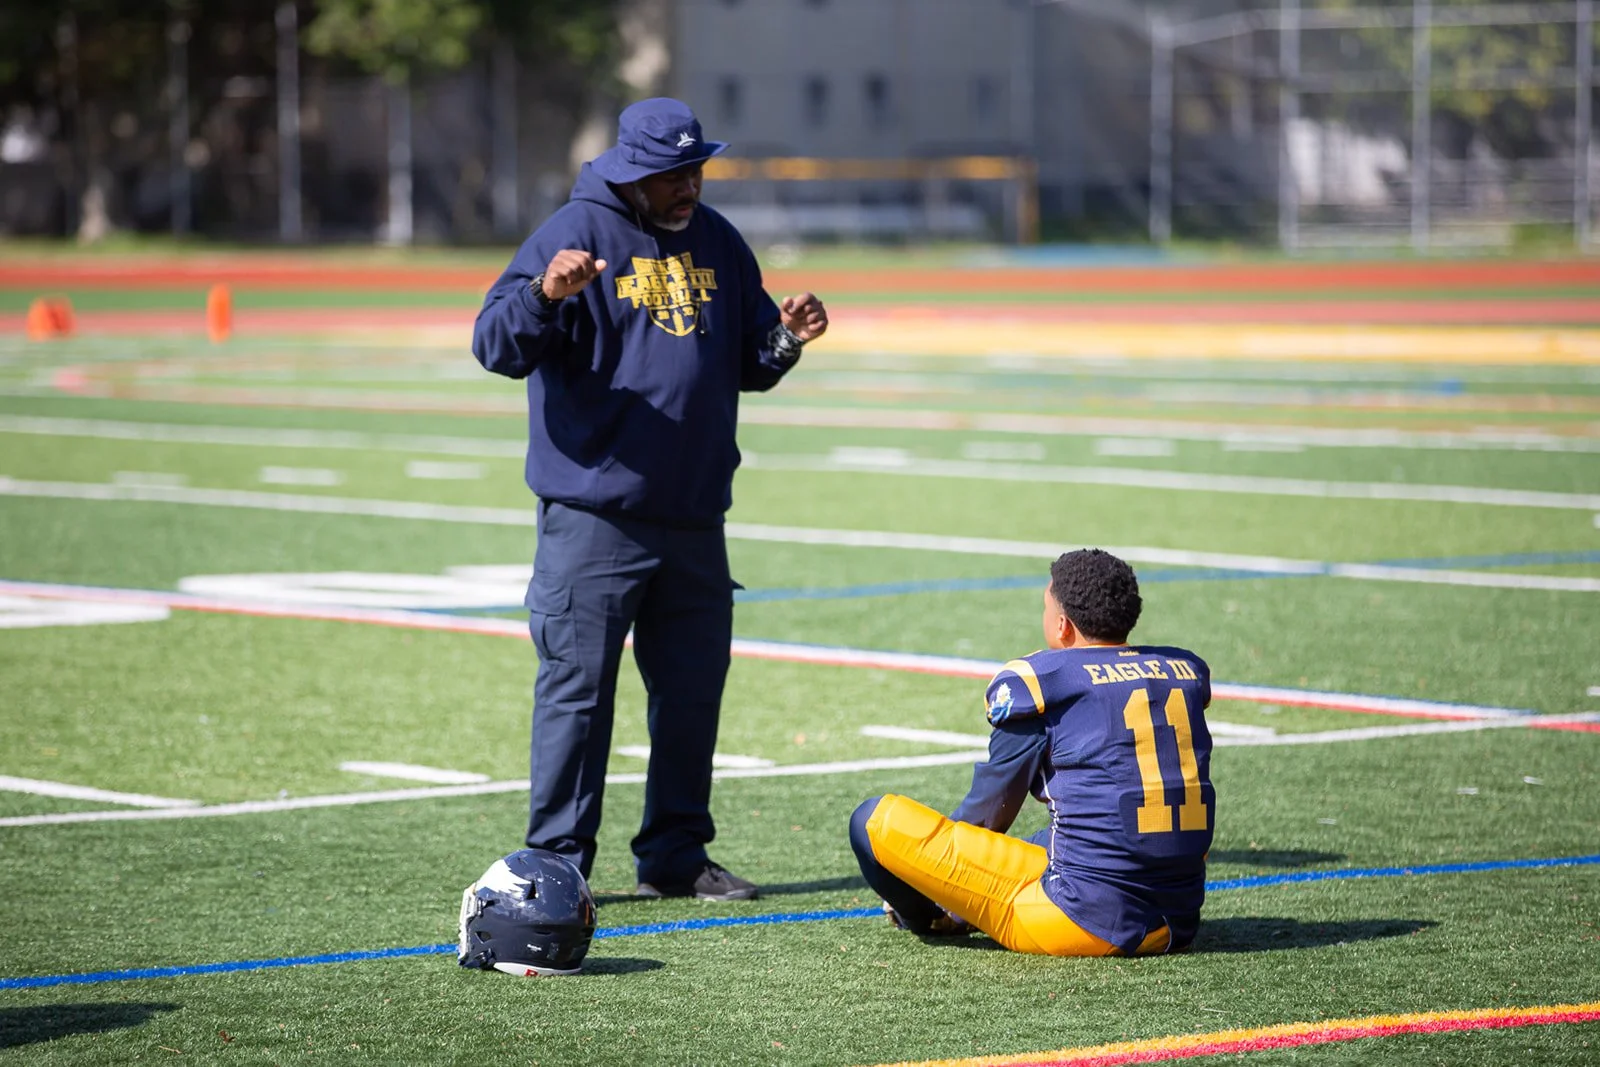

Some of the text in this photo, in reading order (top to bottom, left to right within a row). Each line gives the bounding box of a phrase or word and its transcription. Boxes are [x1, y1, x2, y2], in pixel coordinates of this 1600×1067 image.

[631, 288, 712, 309] FOOTBAL
[1082, 659, 1198, 685] EAGLE III
[1122, 687, 1207, 834] 11
